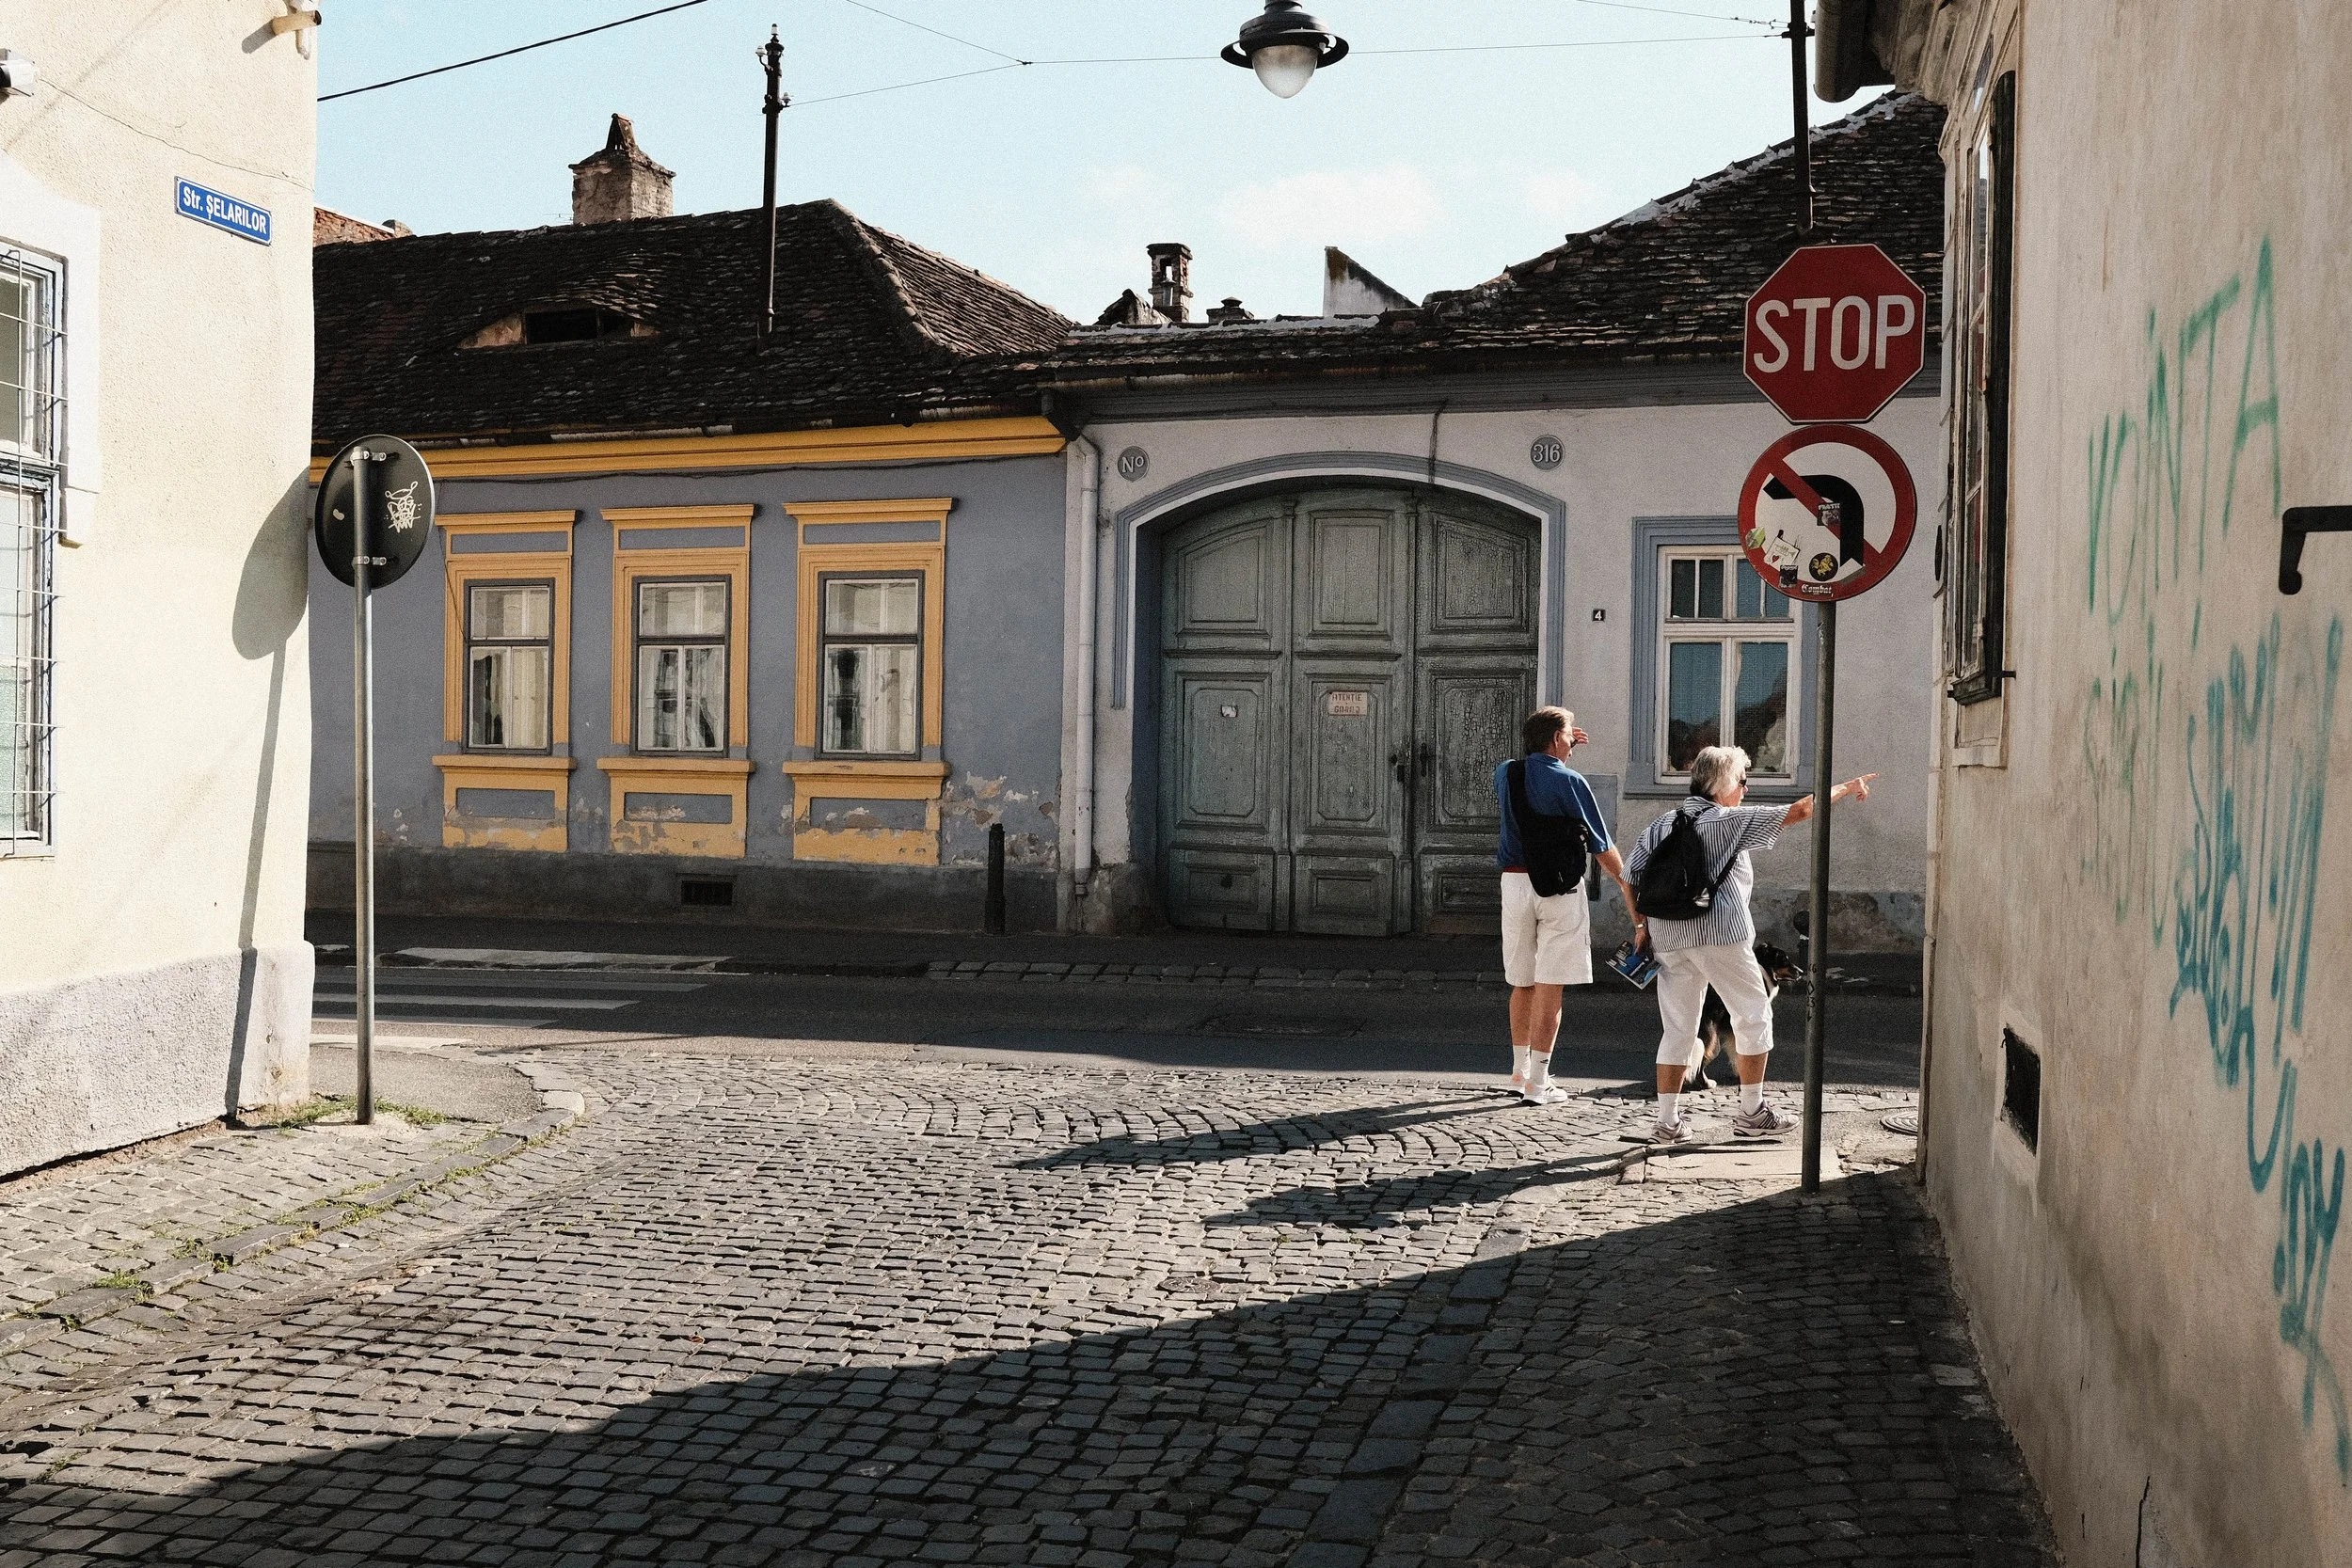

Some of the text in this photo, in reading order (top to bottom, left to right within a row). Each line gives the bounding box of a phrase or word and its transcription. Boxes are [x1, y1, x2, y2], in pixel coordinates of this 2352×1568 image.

[183, 186, 203, 212] Str.
[1754, 295, 1915, 373] STOP
[1534, 444, 1560, 463] 316
[1595, 610, 1602, 621] 4
